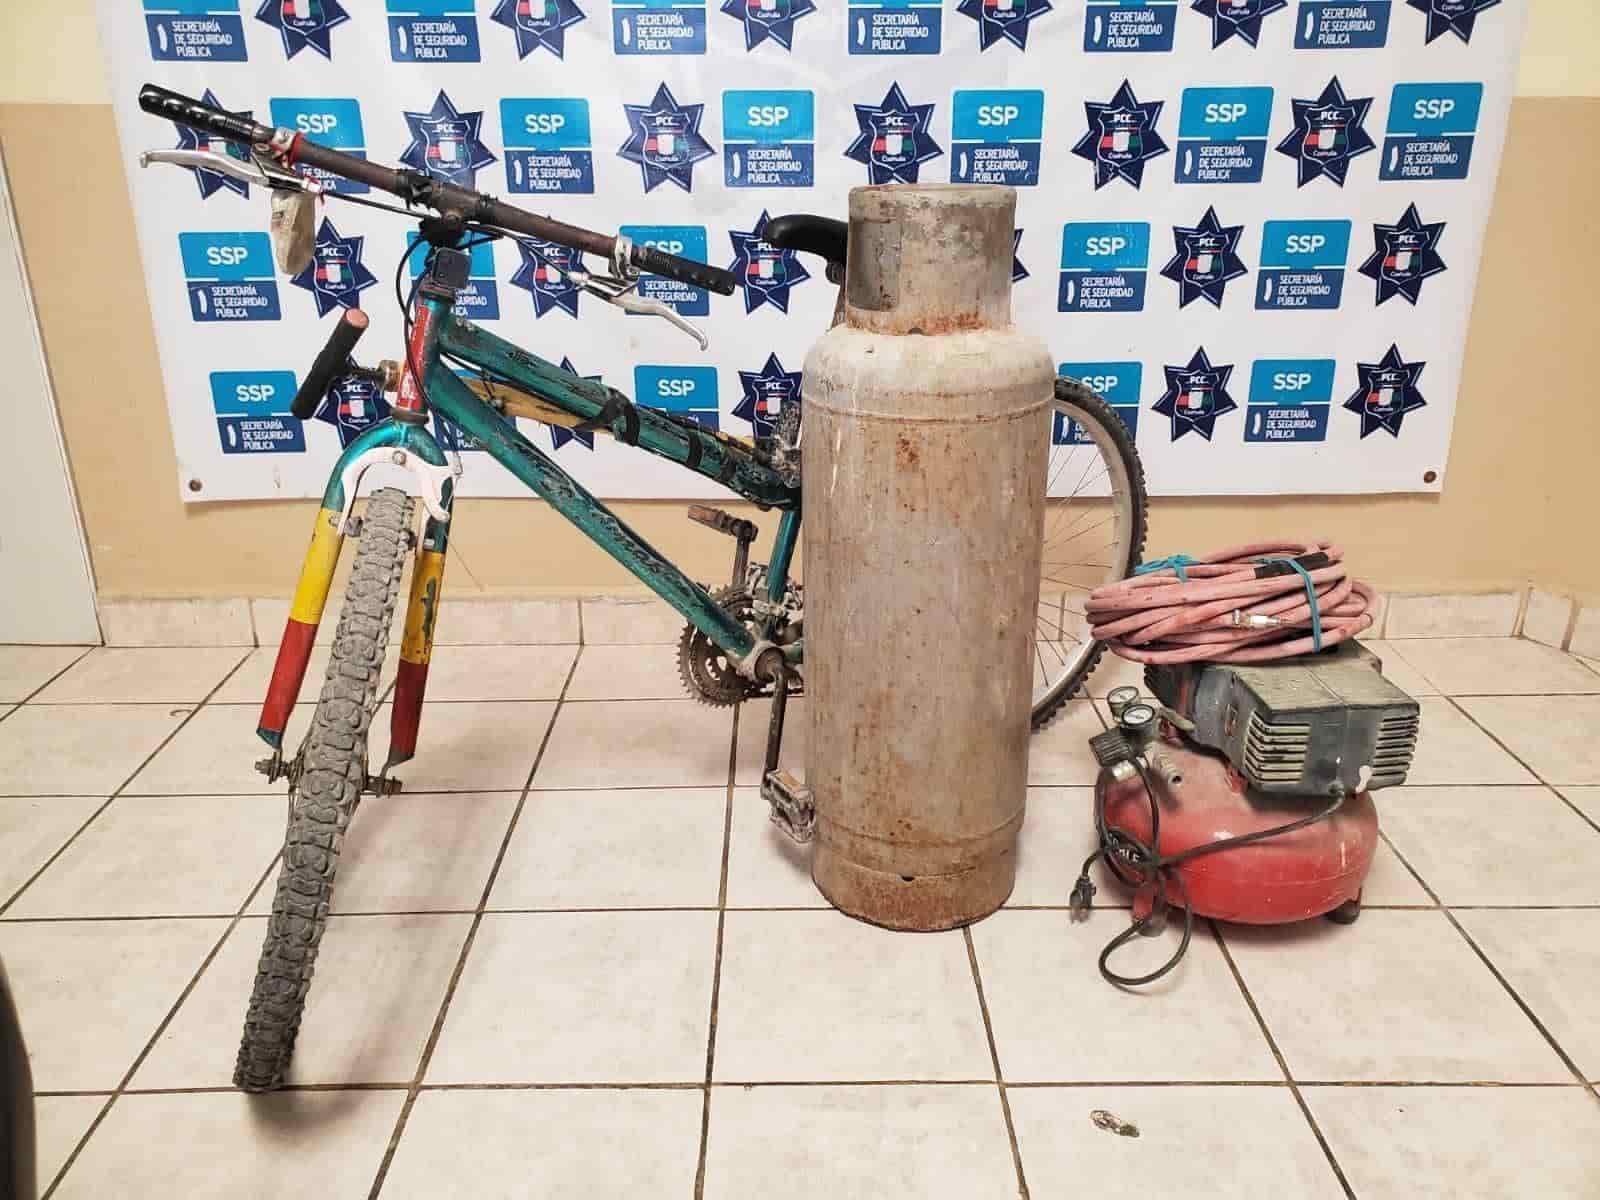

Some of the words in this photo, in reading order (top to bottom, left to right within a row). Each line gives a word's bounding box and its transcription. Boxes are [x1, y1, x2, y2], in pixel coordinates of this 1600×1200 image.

[636, 13, 684, 26] SECRETARÍA
[872, 13, 920, 25] SECRETARÍA
[1110, 10, 1154, 22] SECRETARÍA
[1322, 7, 1367, 20] SECRETARÍA
[172, 20, 221, 33] SECRETARÍA
[412, 20, 456, 33] SECRETARÍA
[637, 25, 649, 38] DE
[651, 25, 694, 38] SEGURIDAD
[872, 25, 885, 37] DE
[888, 25, 928, 37] SEGURIDAD
[1108, 23, 1120, 35] DE
[1122, 23, 1162, 35] SEGURIDAD
[1321, 19, 1332, 32] DE
[1335, 19, 1376, 32] SEGURIDAD
[174, 32, 185, 45] DE
[188, 32, 232, 45] SEGURIDAD
[414, 33, 423, 45] DE
[426, 33, 467, 45] SEGURIDAD
[638, 36, 672, 50] PÚBLICA
[872, 37, 906, 50] PÚBLICA
[1107, 35, 1139, 48] PÚBLICA
[1318, 31, 1350, 45] PÚBLICA
[176, 44, 211, 57] PÚBLICA
[415, 44, 448, 58] PÚBLICA
[977, 105, 1018, 126] SSP
[1205, 103, 1247, 123] SSP
[1414, 99, 1454, 119] SSP
[747, 106, 789, 126] SSP
[296, 114, 337, 133] SSP
[525, 114, 565, 133] SSP
[974, 147, 1019, 160] SECRETARÍA
[1200, 144, 1245, 157] SECRETARÍA
[1406, 141, 1450, 154] SECRETARÍA
[747, 148, 792, 161] SECRETARÍA
[1404, 153, 1415, 165] DE
[1418, 153, 1457, 165] SEGURIDAD
[527, 155, 570, 168] SECRETARÍA
[748, 160, 758, 172] DE
[761, 160, 802, 172] SEGURIDAD
[974, 160, 984, 171] DE
[987, 160, 1026, 171] SEGURIDAD
[1199, 157, 1210, 168] DE
[1213, 157, 1252, 168] SEGURIDAD
[529, 167, 539, 179] DE
[541, 167, 582, 179] SEGURIDAD
[973, 170, 1005, 183] PÚBLICA
[1198, 168, 1230, 180] PÚBLICA
[1402, 164, 1433, 176] PÚBLICA
[530, 178, 561, 190] PÚBLICA
[748, 171, 780, 184] PÚBLICA
[1086, 236, 1126, 256] SSP
[1286, 234, 1325, 254] SSP
[207, 246, 248, 265] SSP
[1081, 275, 1125, 287] SECRETARÍA
[1280, 272, 1323, 284] SECRETARÍA
[212, 285, 256, 297] SECRETARÍA
[1081, 287, 1091, 298] DE
[1094, 287, 1133, 298] SEGURIDAD
[1279, 284, 1290, 295] DE
[1293, 284, 1330, 295] SEGURIDAD
[214, 296, 225, 307] DE
[228, 296, 267, 307] SEGURIDAD
[657, 292, 697, 302] SEGURIDAD
[1080, 297, 1111, 309] PÚBLICA
[1277, 295, 1307, 306] PÚBLICA
[216, 307, 248, 319] PÚBLICA
[658, 379, 695, 396] SSP
[1273, 373, 1311, 391] SSP
[236, 384, 274, 401] SSP
[1268, 408, 1309, 419] SECRETARÍA
[240, 420, 284, 431] SECRETARÍA
[1266, 419, 1276, 430] DE
[1279, 419, 1316, 430] SEGURIDAD
[242, 430, 253, 441] DE
[255, 430, 293, 441] SEGURIDAD
[1266, 429, 1295, 440] PÚBLICA
[244, 440, 274, 451] PÚBLICA
